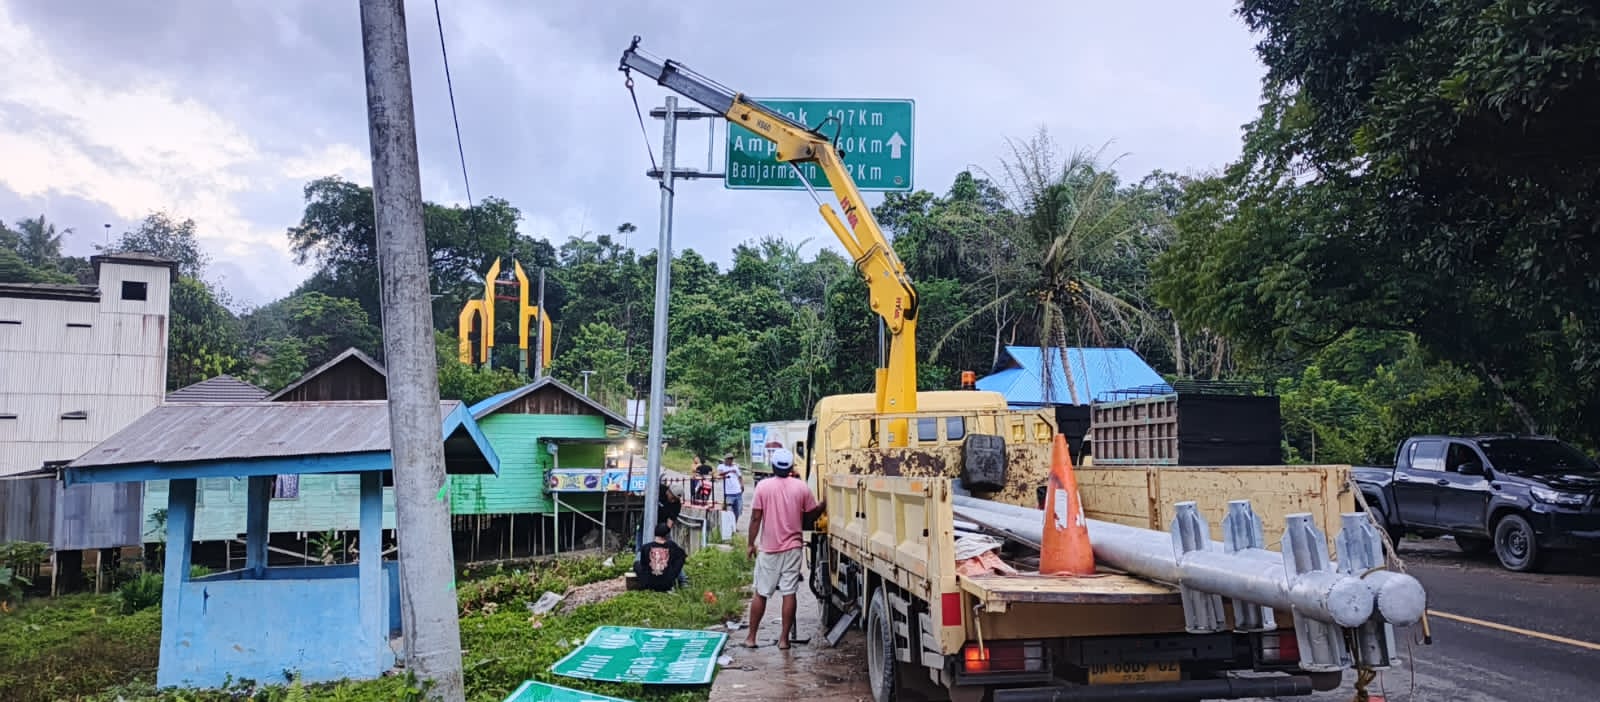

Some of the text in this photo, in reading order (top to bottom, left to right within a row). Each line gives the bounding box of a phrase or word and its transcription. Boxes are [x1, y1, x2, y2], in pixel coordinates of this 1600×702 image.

[734, 136, 883, 156] Amp 60Km
[846, 163, 882, 180] 2Km
